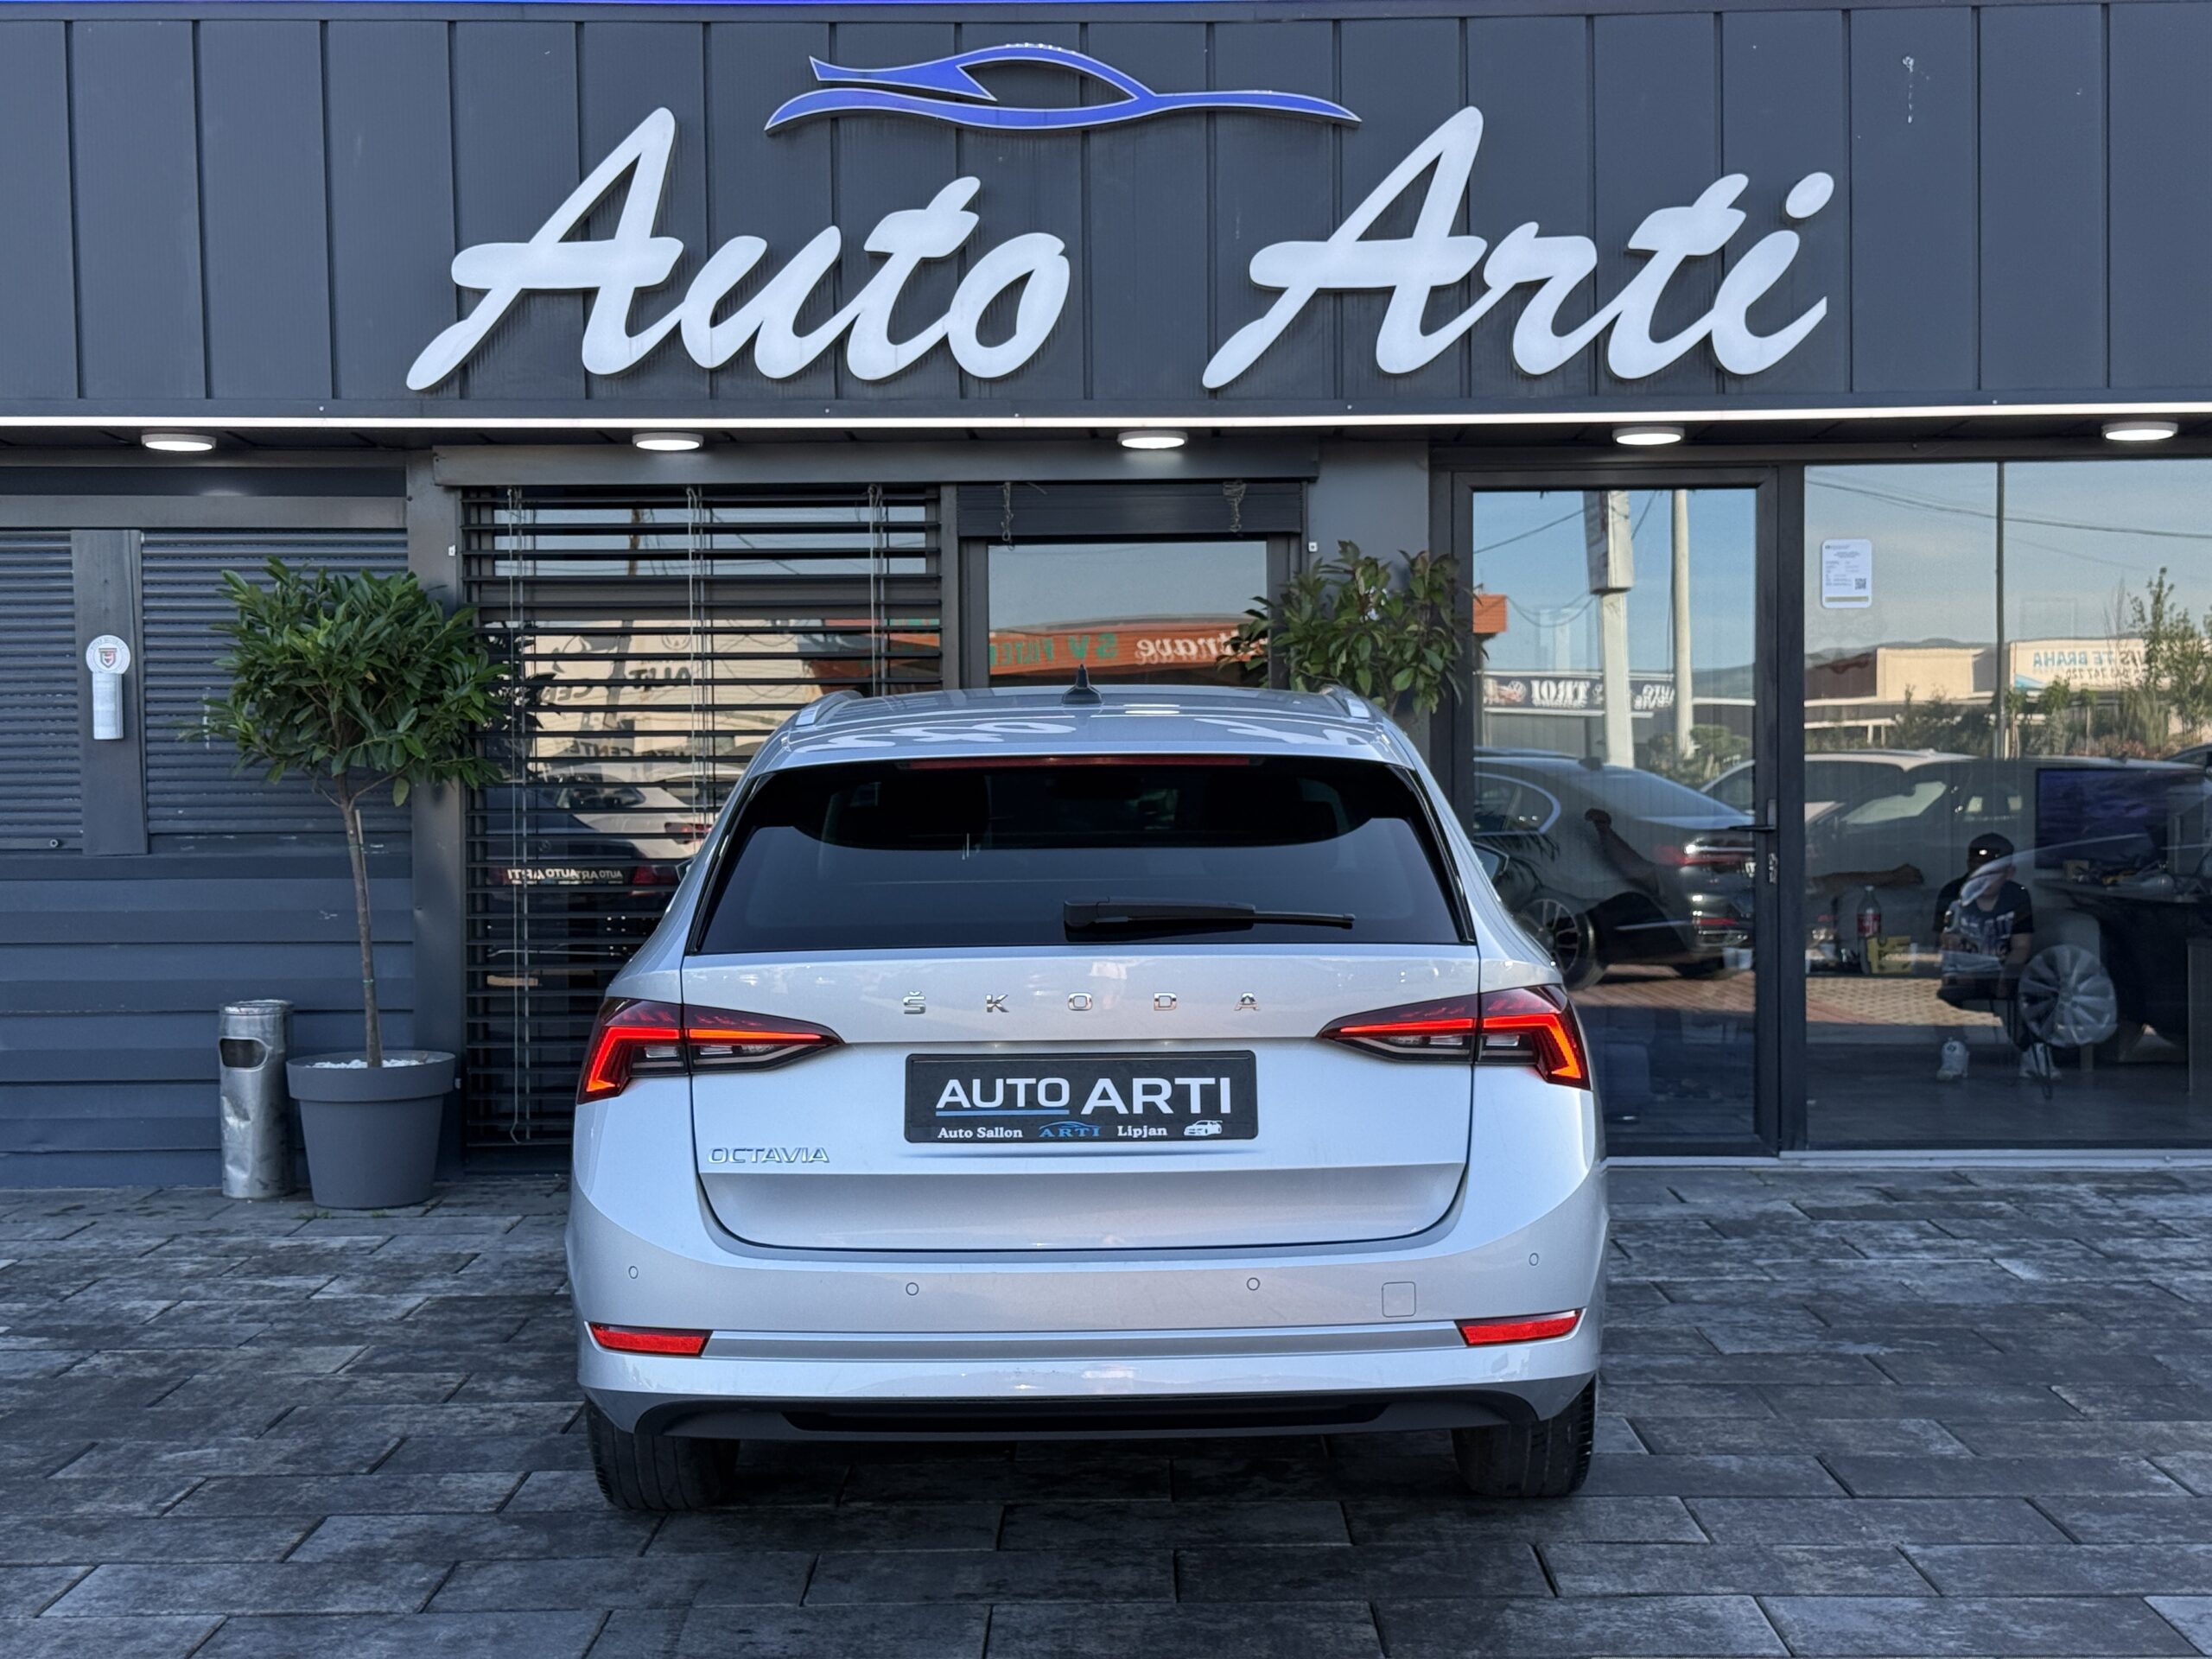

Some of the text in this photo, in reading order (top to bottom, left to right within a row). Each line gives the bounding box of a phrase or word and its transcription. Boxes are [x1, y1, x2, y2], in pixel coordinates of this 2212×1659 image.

[406, 105, 1836, 391] Auto Arti
[903, 990, 1261, 1015] ŠKODA
[936, 1077, 1231, 1115] AUTO ARTI
[938, 1125, 1167, 1140] Auto Sallon ARTI Lipjan
[708, 1147, 830, 1164] OCTAVIA
